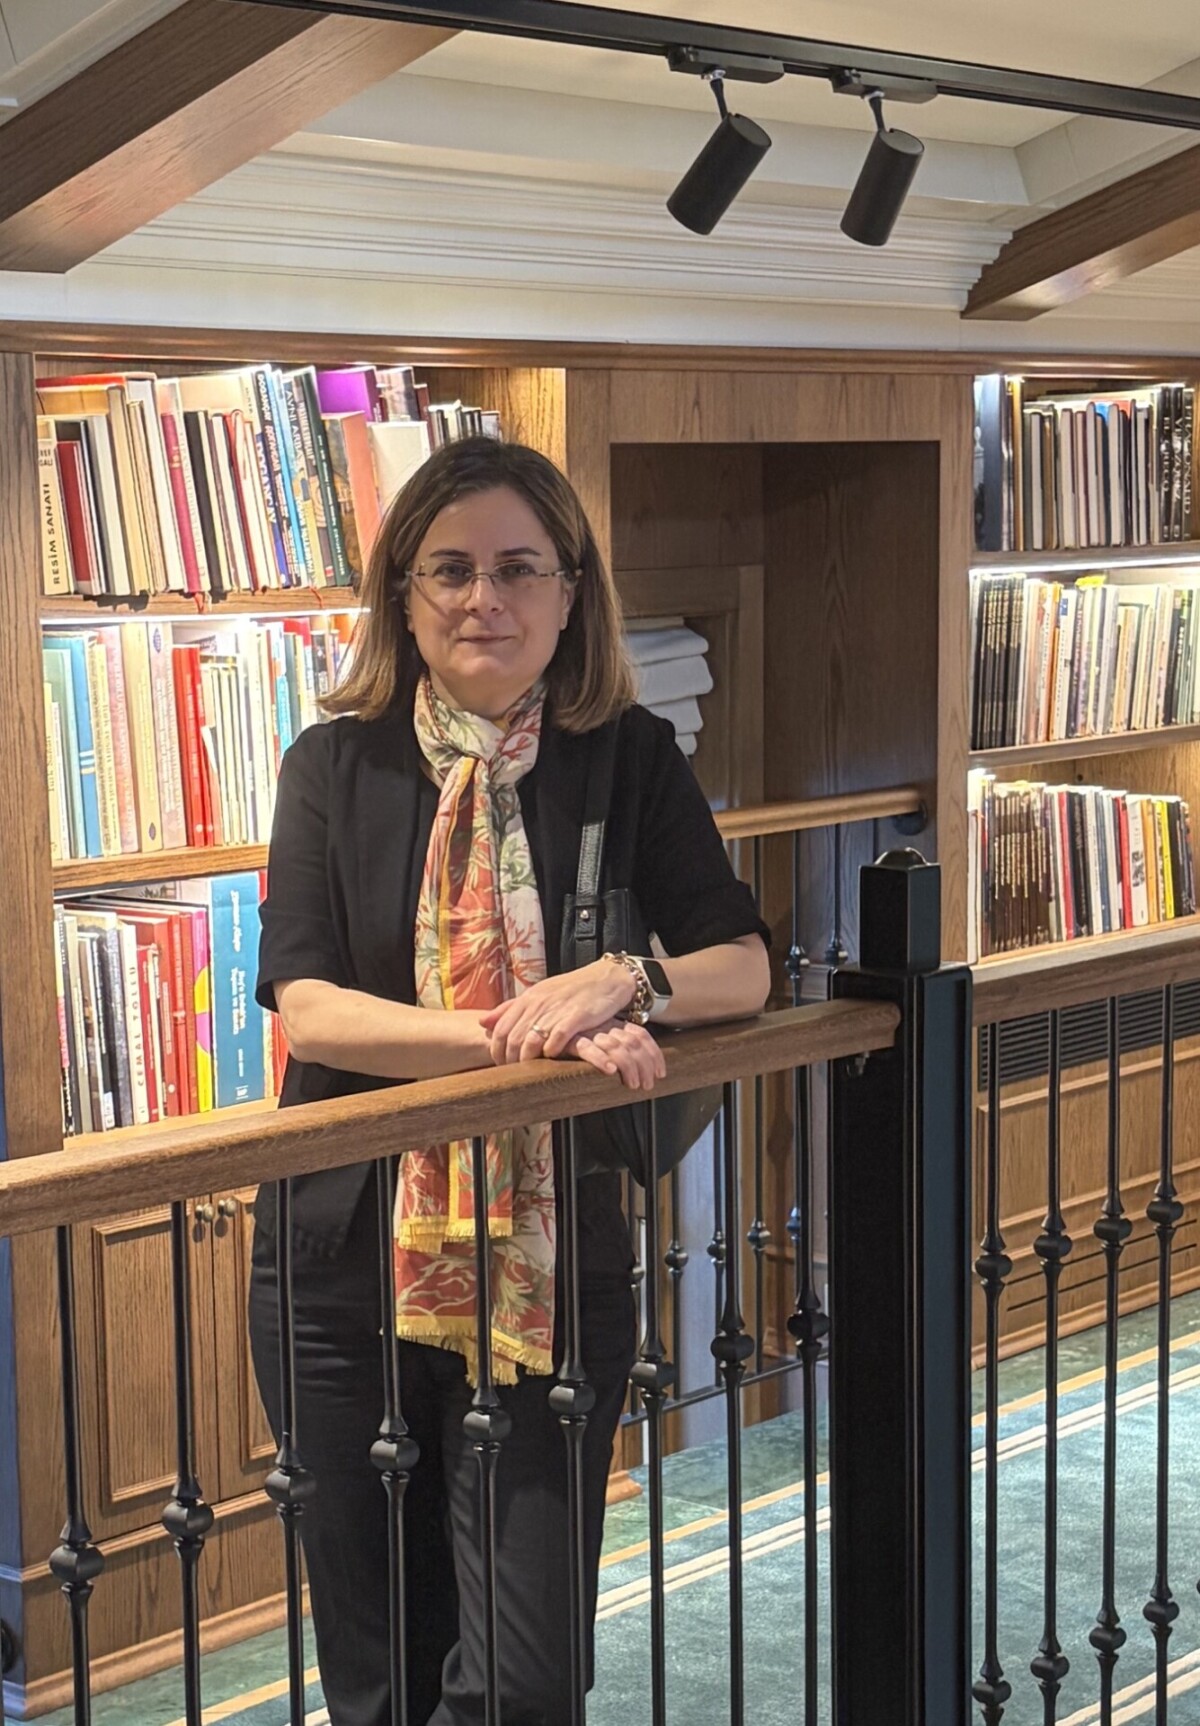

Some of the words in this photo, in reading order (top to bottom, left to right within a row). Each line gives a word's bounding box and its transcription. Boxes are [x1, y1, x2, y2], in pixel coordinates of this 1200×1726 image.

[43, 483, 56, 535] SANATI
[48, 540, 61, 585] RESİM
[129, 966, 139, 1021] TOLLU
[134, 1034, 145, 1086] CEMAL
